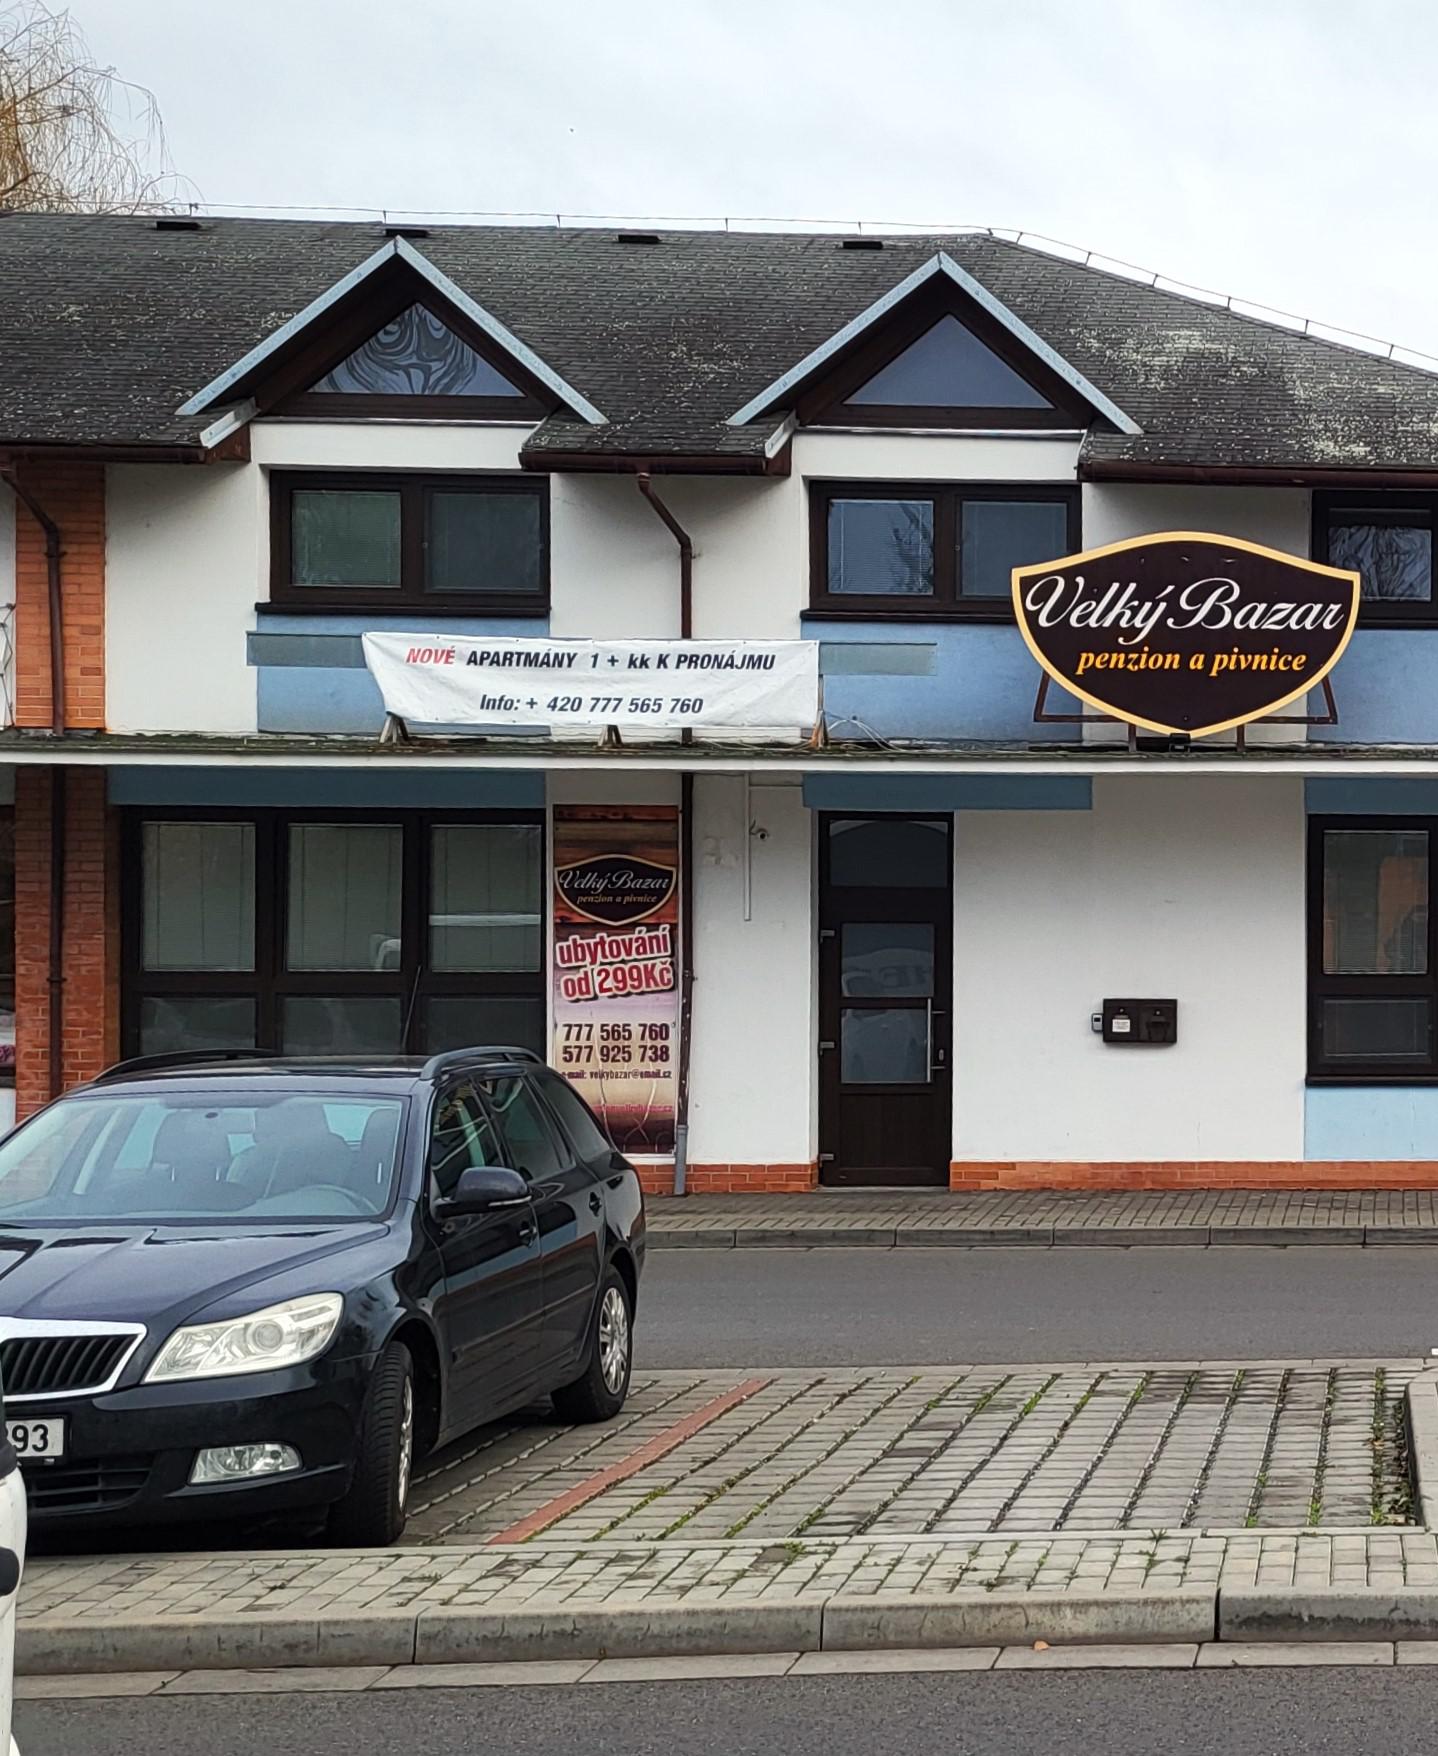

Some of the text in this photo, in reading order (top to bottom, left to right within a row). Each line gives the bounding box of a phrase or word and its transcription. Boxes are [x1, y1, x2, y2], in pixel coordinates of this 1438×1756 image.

[1025, 575, 1344, 645] Velký Bazar
[405, 645, 776, 671] NOVÉ APARTMÁNY 1 + kk K PRONÁJMU
[1076, 646, 1307, 676] penzion a pivnice
[479, 694, 704, 714] Info: + 420 777 565 760
[559, 870, 669, 894] Velký Bazar
[577, 894, 614, 904] penzion
[623, 894, 657, 904] pivnice
[557, 925, 671, 967] ubytování
[562, 960, 672, 998] od 299Kč
[562, 1023, 670, 1041] 777 565 760
[562, 1045, 670, 1063] 577 925 738
[6, 1424, 49, 1452] 93
